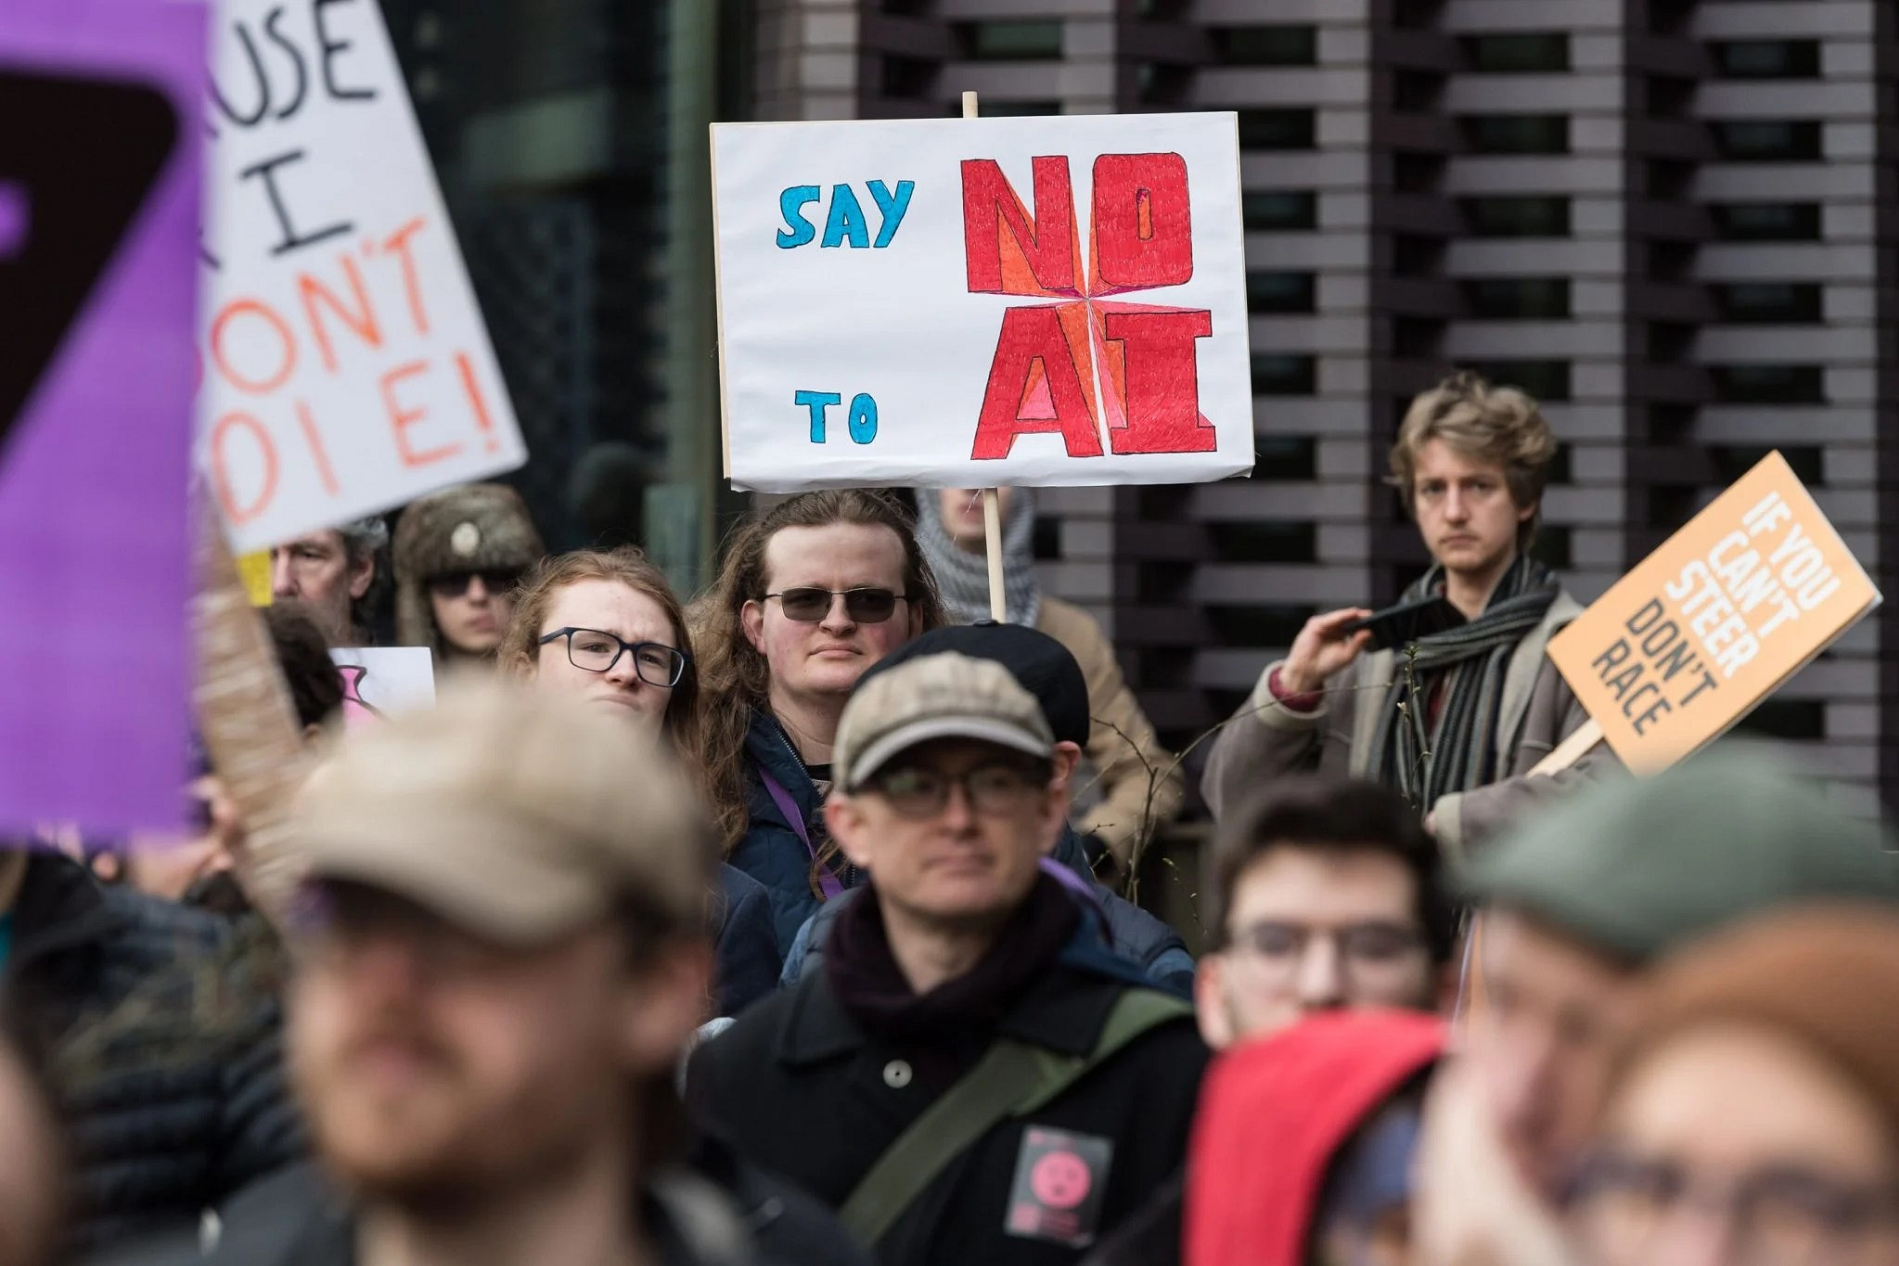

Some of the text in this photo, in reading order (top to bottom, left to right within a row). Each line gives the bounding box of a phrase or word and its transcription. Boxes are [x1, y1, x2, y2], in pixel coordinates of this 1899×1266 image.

[204, 0, 379, 132] USE
[776, 151, 1193, 294] SAY NO
[199, 216, 430, 394] ON'T
[209, 351, 499, 526] DIE!
[794, 305, 1217, 460] TO AI
[1708, 530, 1799, 638] CAN'T
[1742, 490, 1842, 611] IF YOU
[1625, 597, 1718, 708] DON'T
[1664, 559, 1760, 679] STEER
[1591, 637, 1673, 737] RACE
